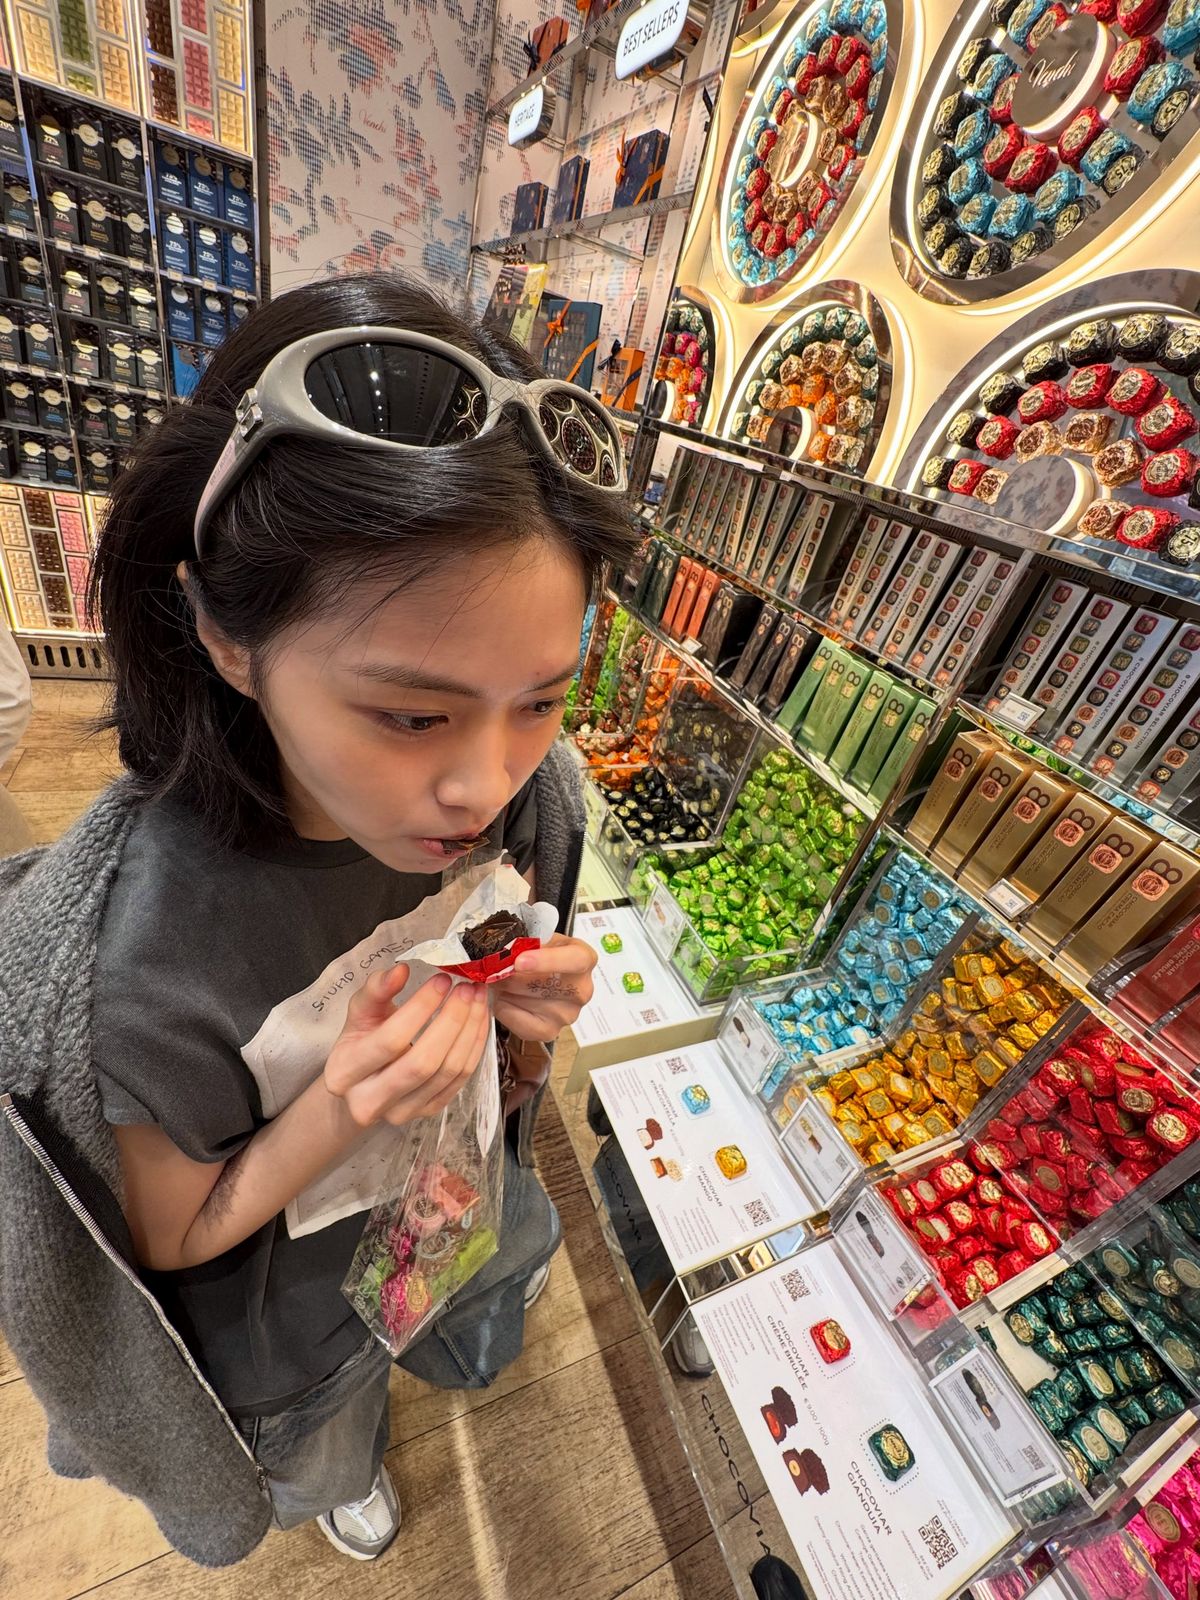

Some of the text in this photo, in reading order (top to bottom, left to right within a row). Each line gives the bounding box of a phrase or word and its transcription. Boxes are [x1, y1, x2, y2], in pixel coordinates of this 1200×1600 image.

[623, 1, 680, 57] BEST SELLERS
[514, 103, 535, 127] HERITAGE
[1091, 697, 1116, 730] SELECTION
[1157, 678, 1186, 717] CHOCOVIAR
[1133, 716, 1159, 750] SELECTION
[1107, 895, 1137, 928] CHOCOVIAR
[359, 937, 414, 969] GAMES
[1166, 943, 1200, 976] CHOCOVIAR
[697, 1174, 713, 1202] MANGO
[699, 1165, 723, 1207] CHOCOVIAR
[777, 1319, 809, 1377] CHOCOVIAR
[818, 1426, 829, 1446] 100g
[847, 1472, 881, 1534] GIANDUIA
[850, 1461, 892, 1536] CHOCOVIAR
